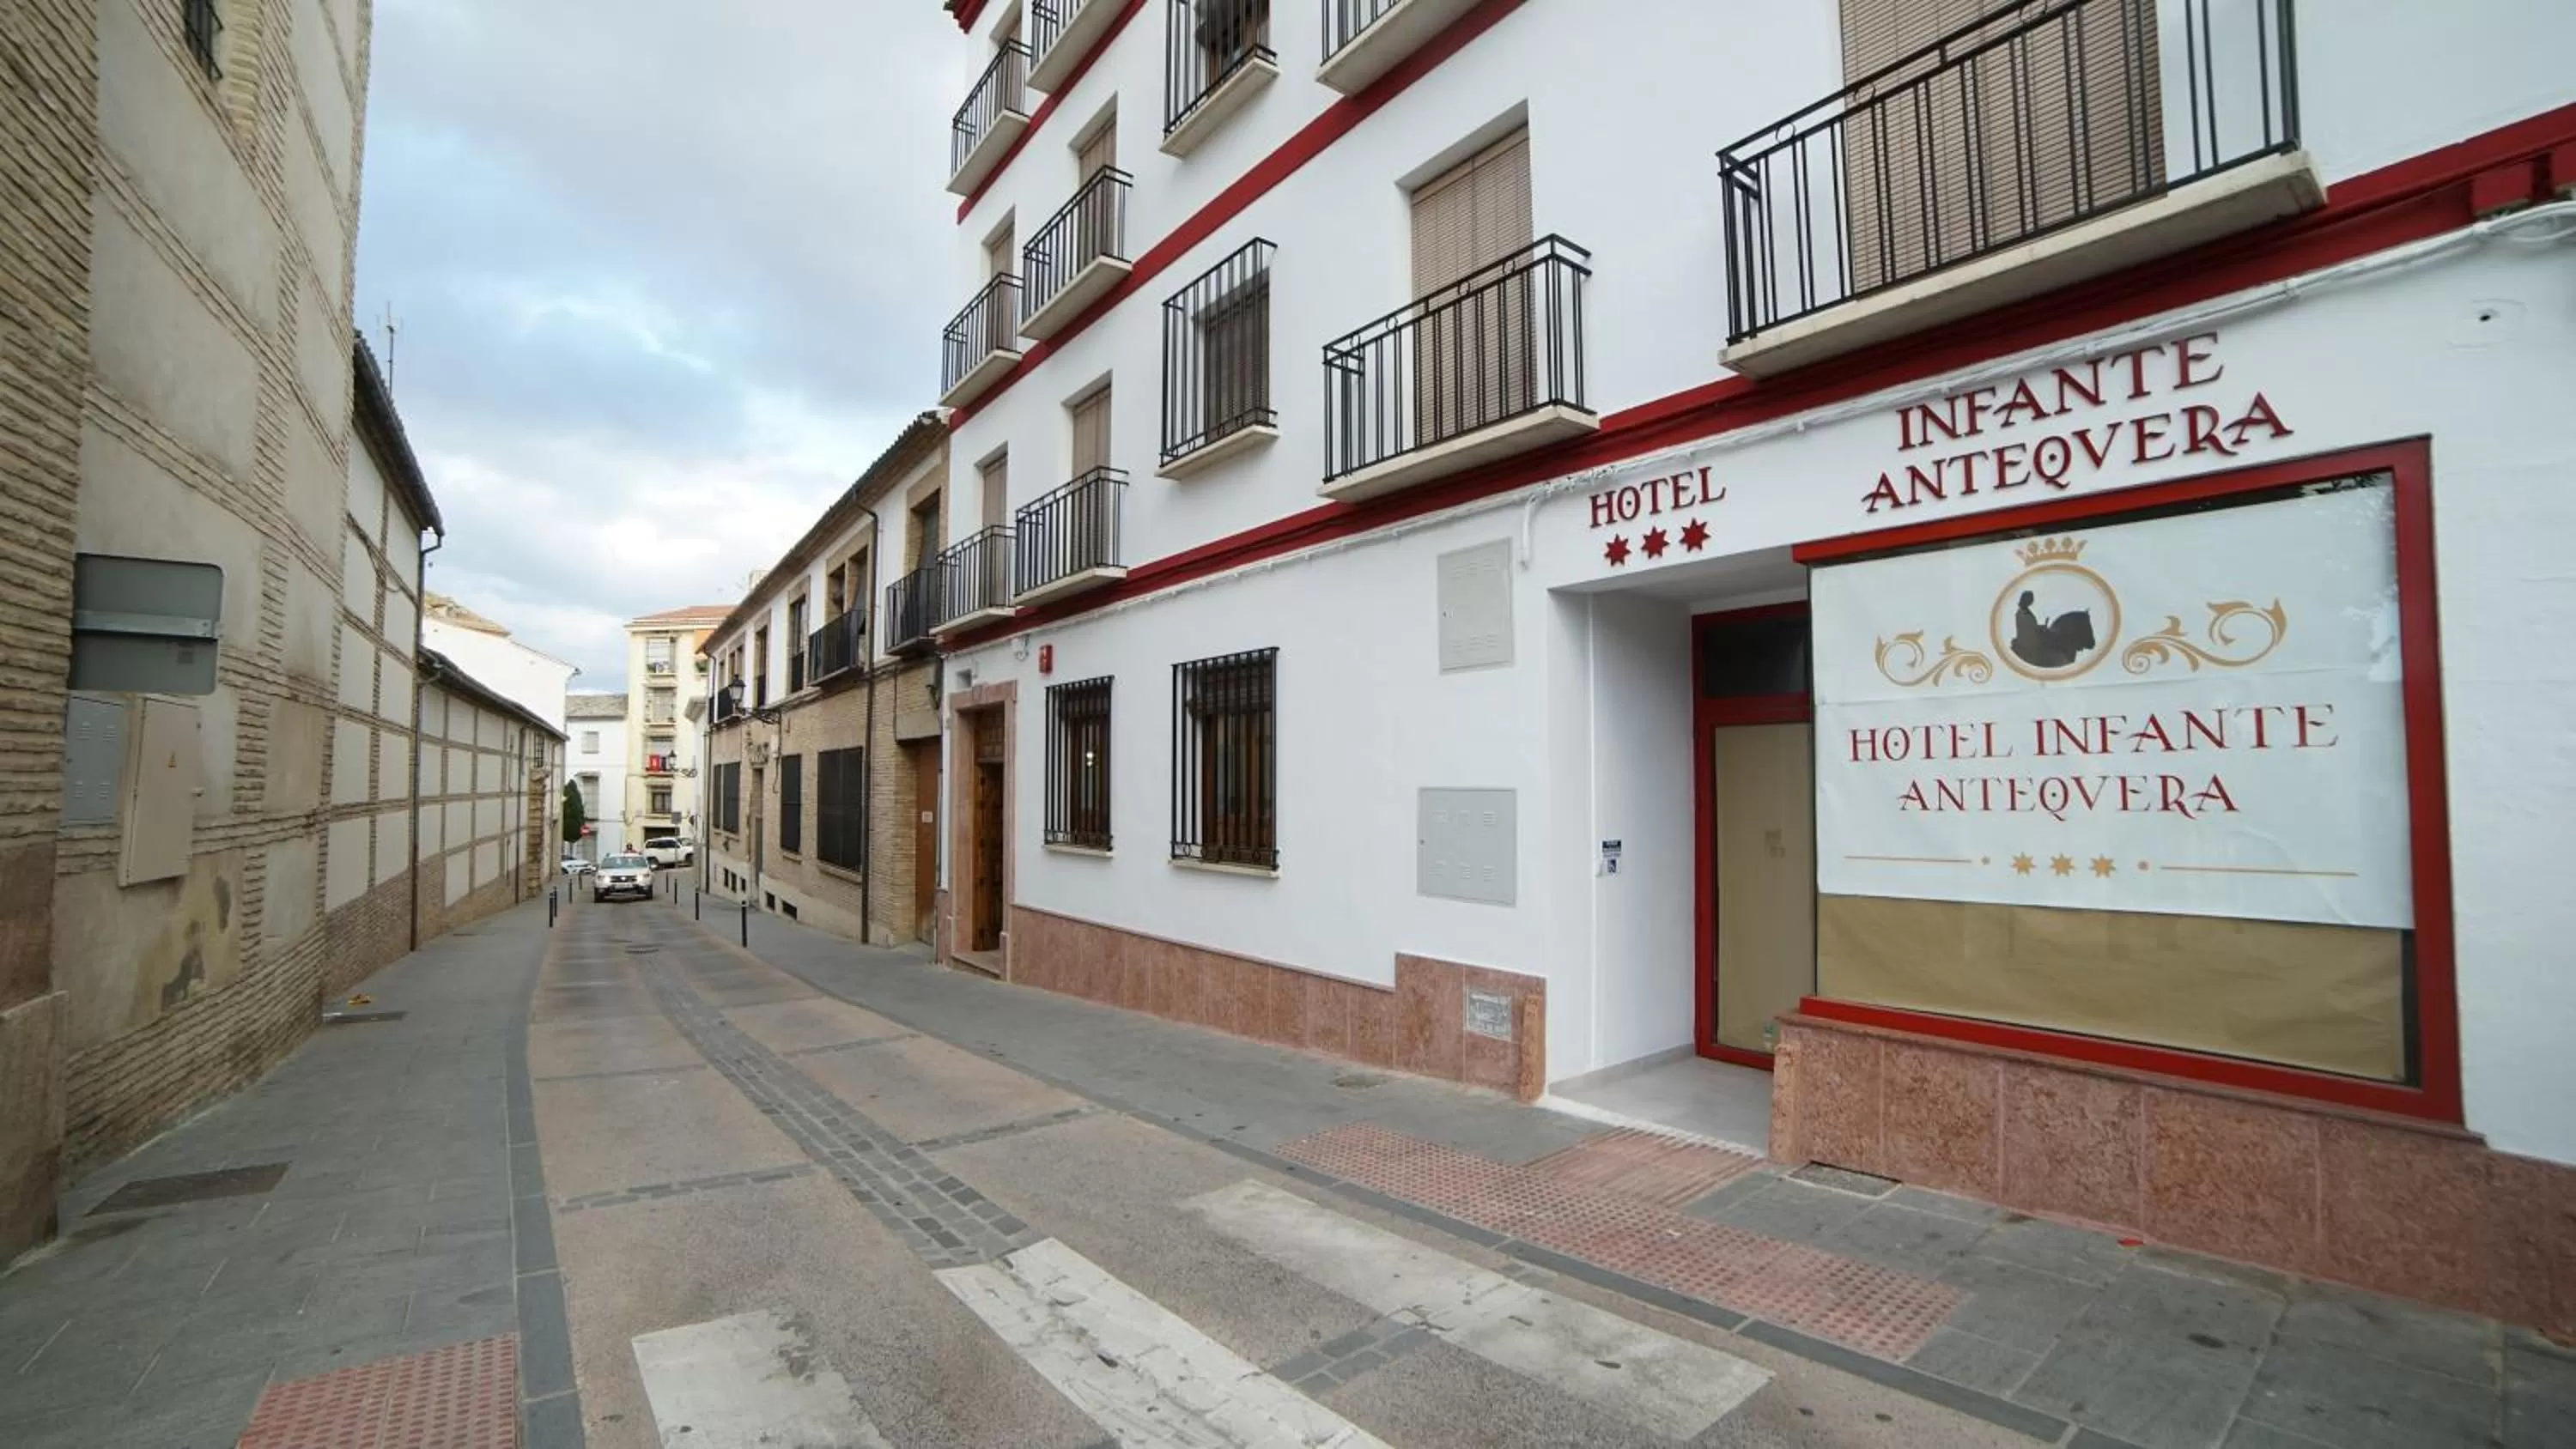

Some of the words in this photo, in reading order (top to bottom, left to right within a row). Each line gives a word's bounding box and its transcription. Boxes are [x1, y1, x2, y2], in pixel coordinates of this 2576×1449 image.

[1896, 330, 2226, 452] INFANTE
[1861, 391, 2293, 514] ANTEQVERA
[1589, 465, 1727, 529] HOTEL
[1848, 720, 2014, 762] HOTEL
[2033, 704, 2340, 757] INFANTE
[1896, 773, 2239, 822] ANTEQVERA
